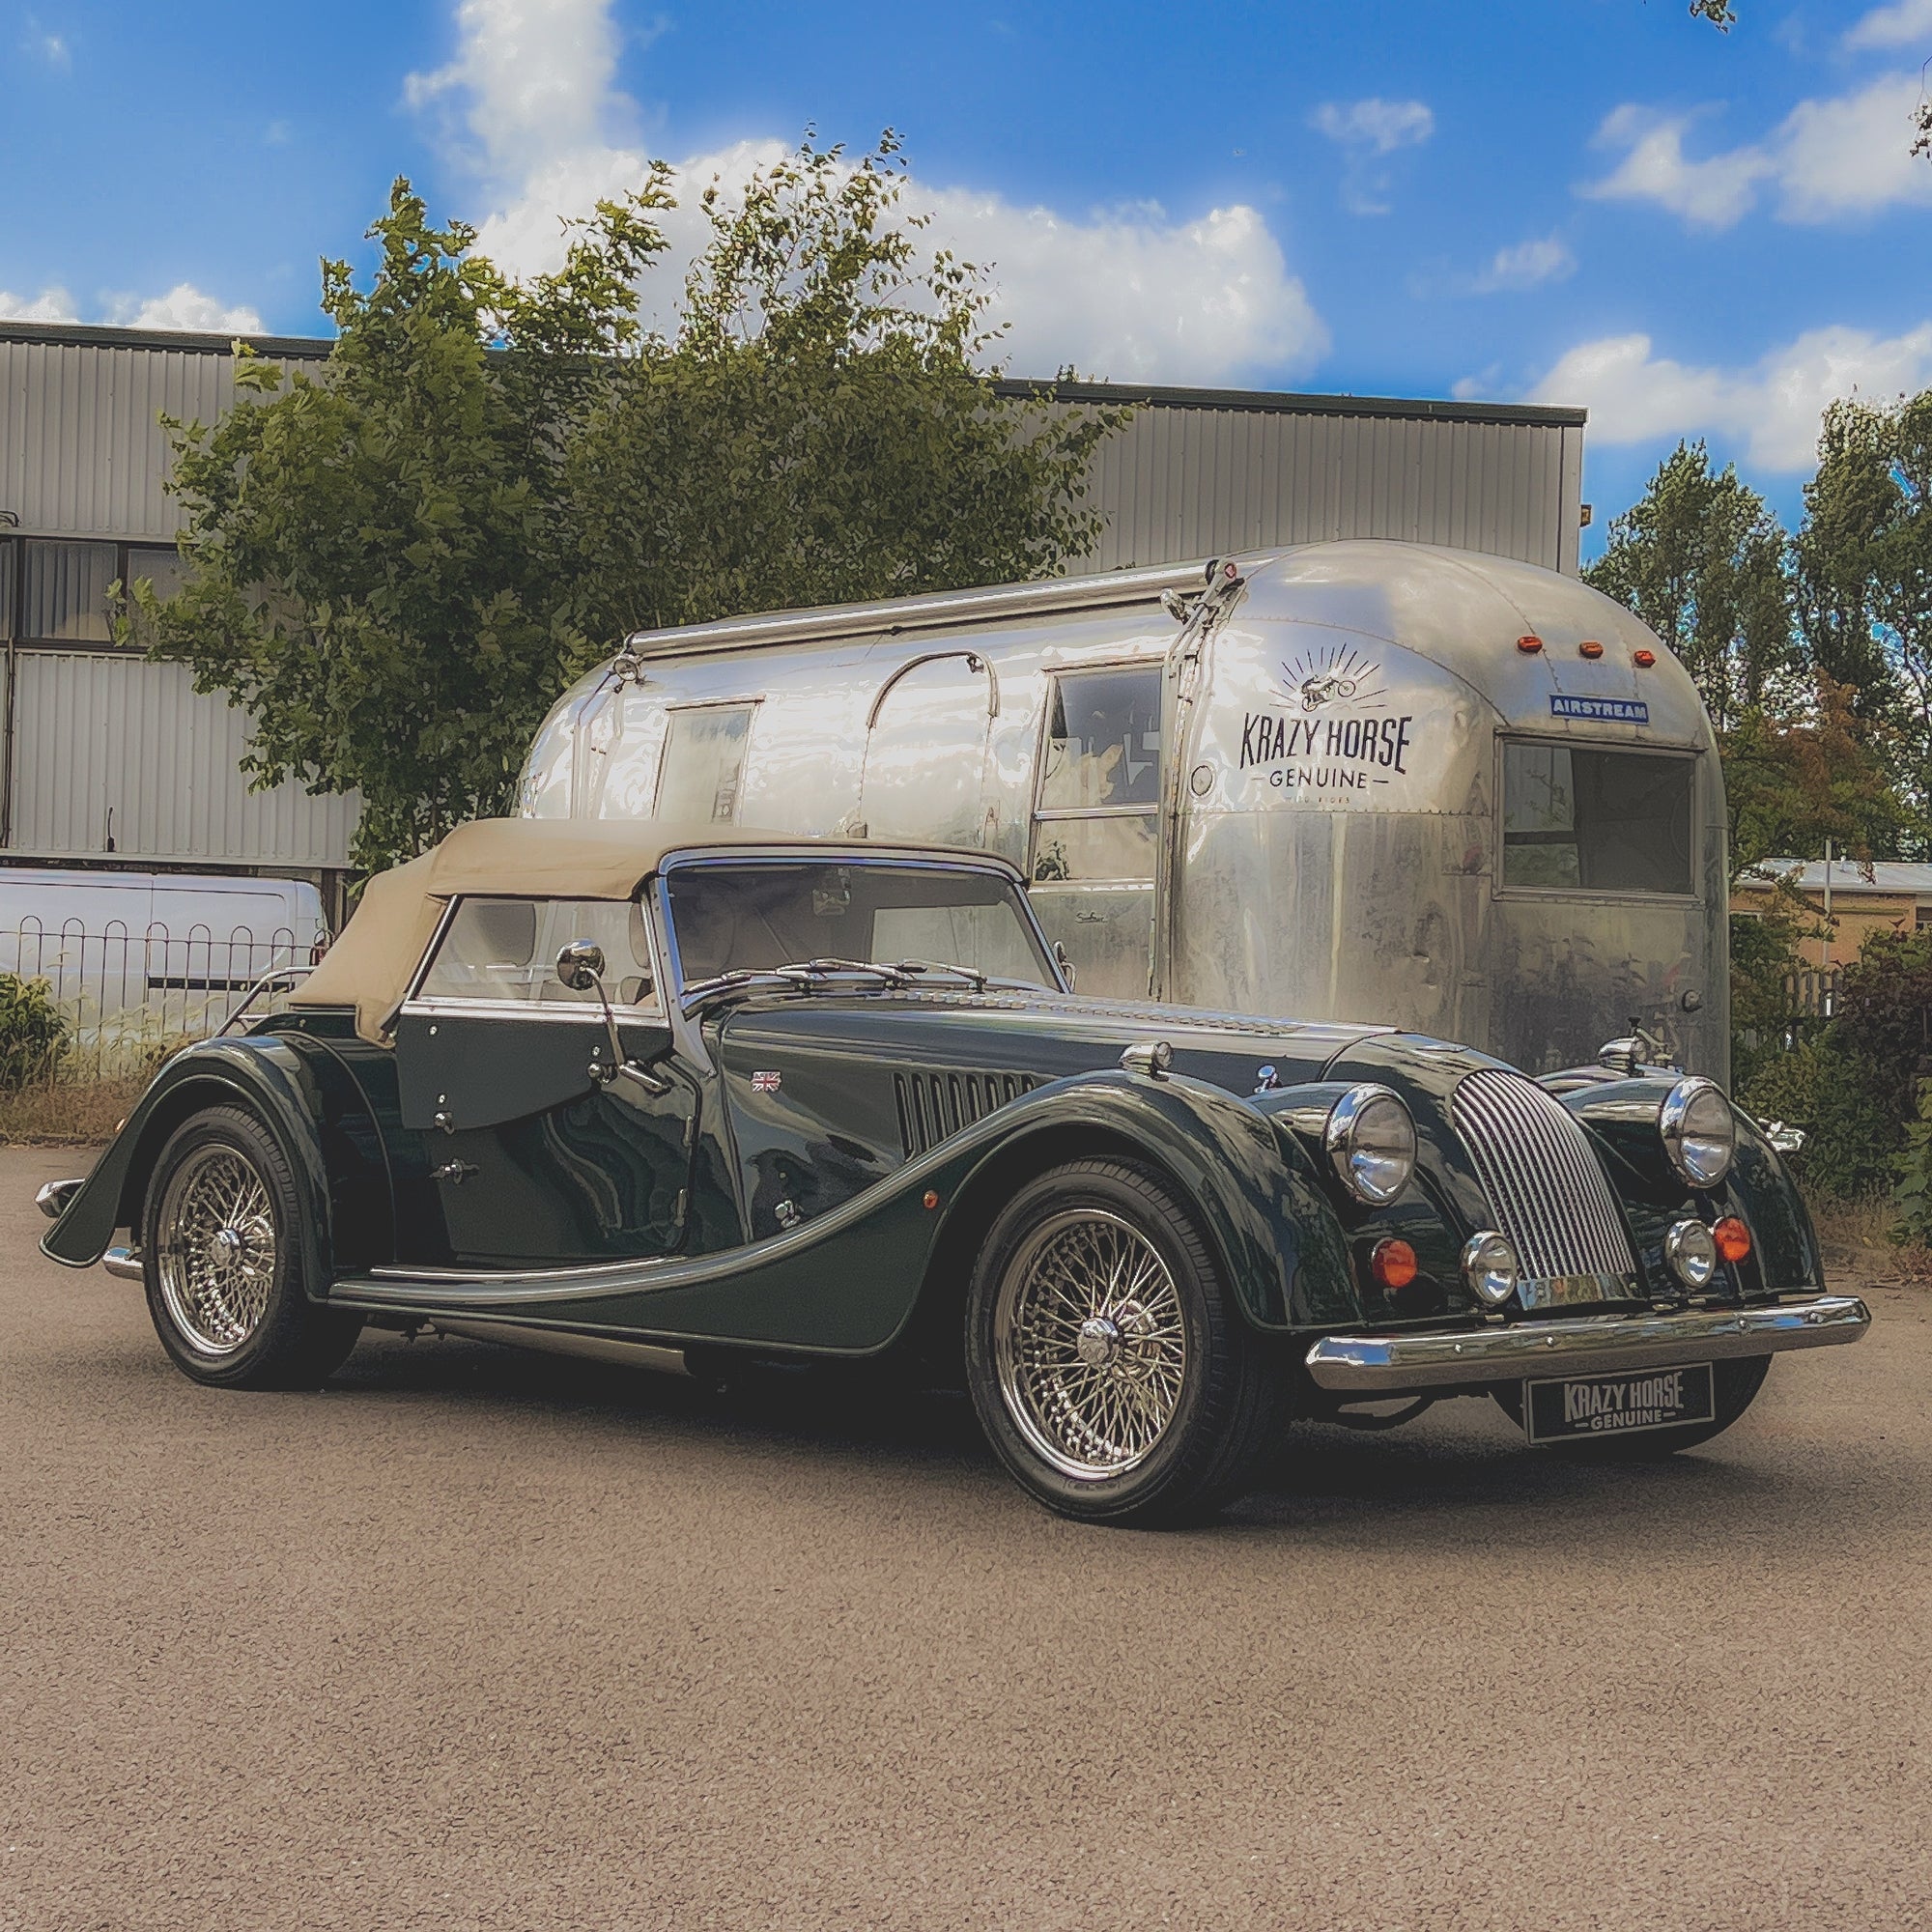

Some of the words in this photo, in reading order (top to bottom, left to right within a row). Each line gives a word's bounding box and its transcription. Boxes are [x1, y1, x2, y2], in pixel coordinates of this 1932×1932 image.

[1553, 698, 1647, 719] AIRSTREAM
[1239, 712, 1321, 770] KRAZY
[1325, 716, 1413, 775] HORSE
[1269, 768, 1368, 789] GENUINE
[1564, 1382, 1627, 1423] KRAZY
[1629, 1371, 1685, 1409] HORSE
[1590, 1408, 1662, 1431] GENUINE
